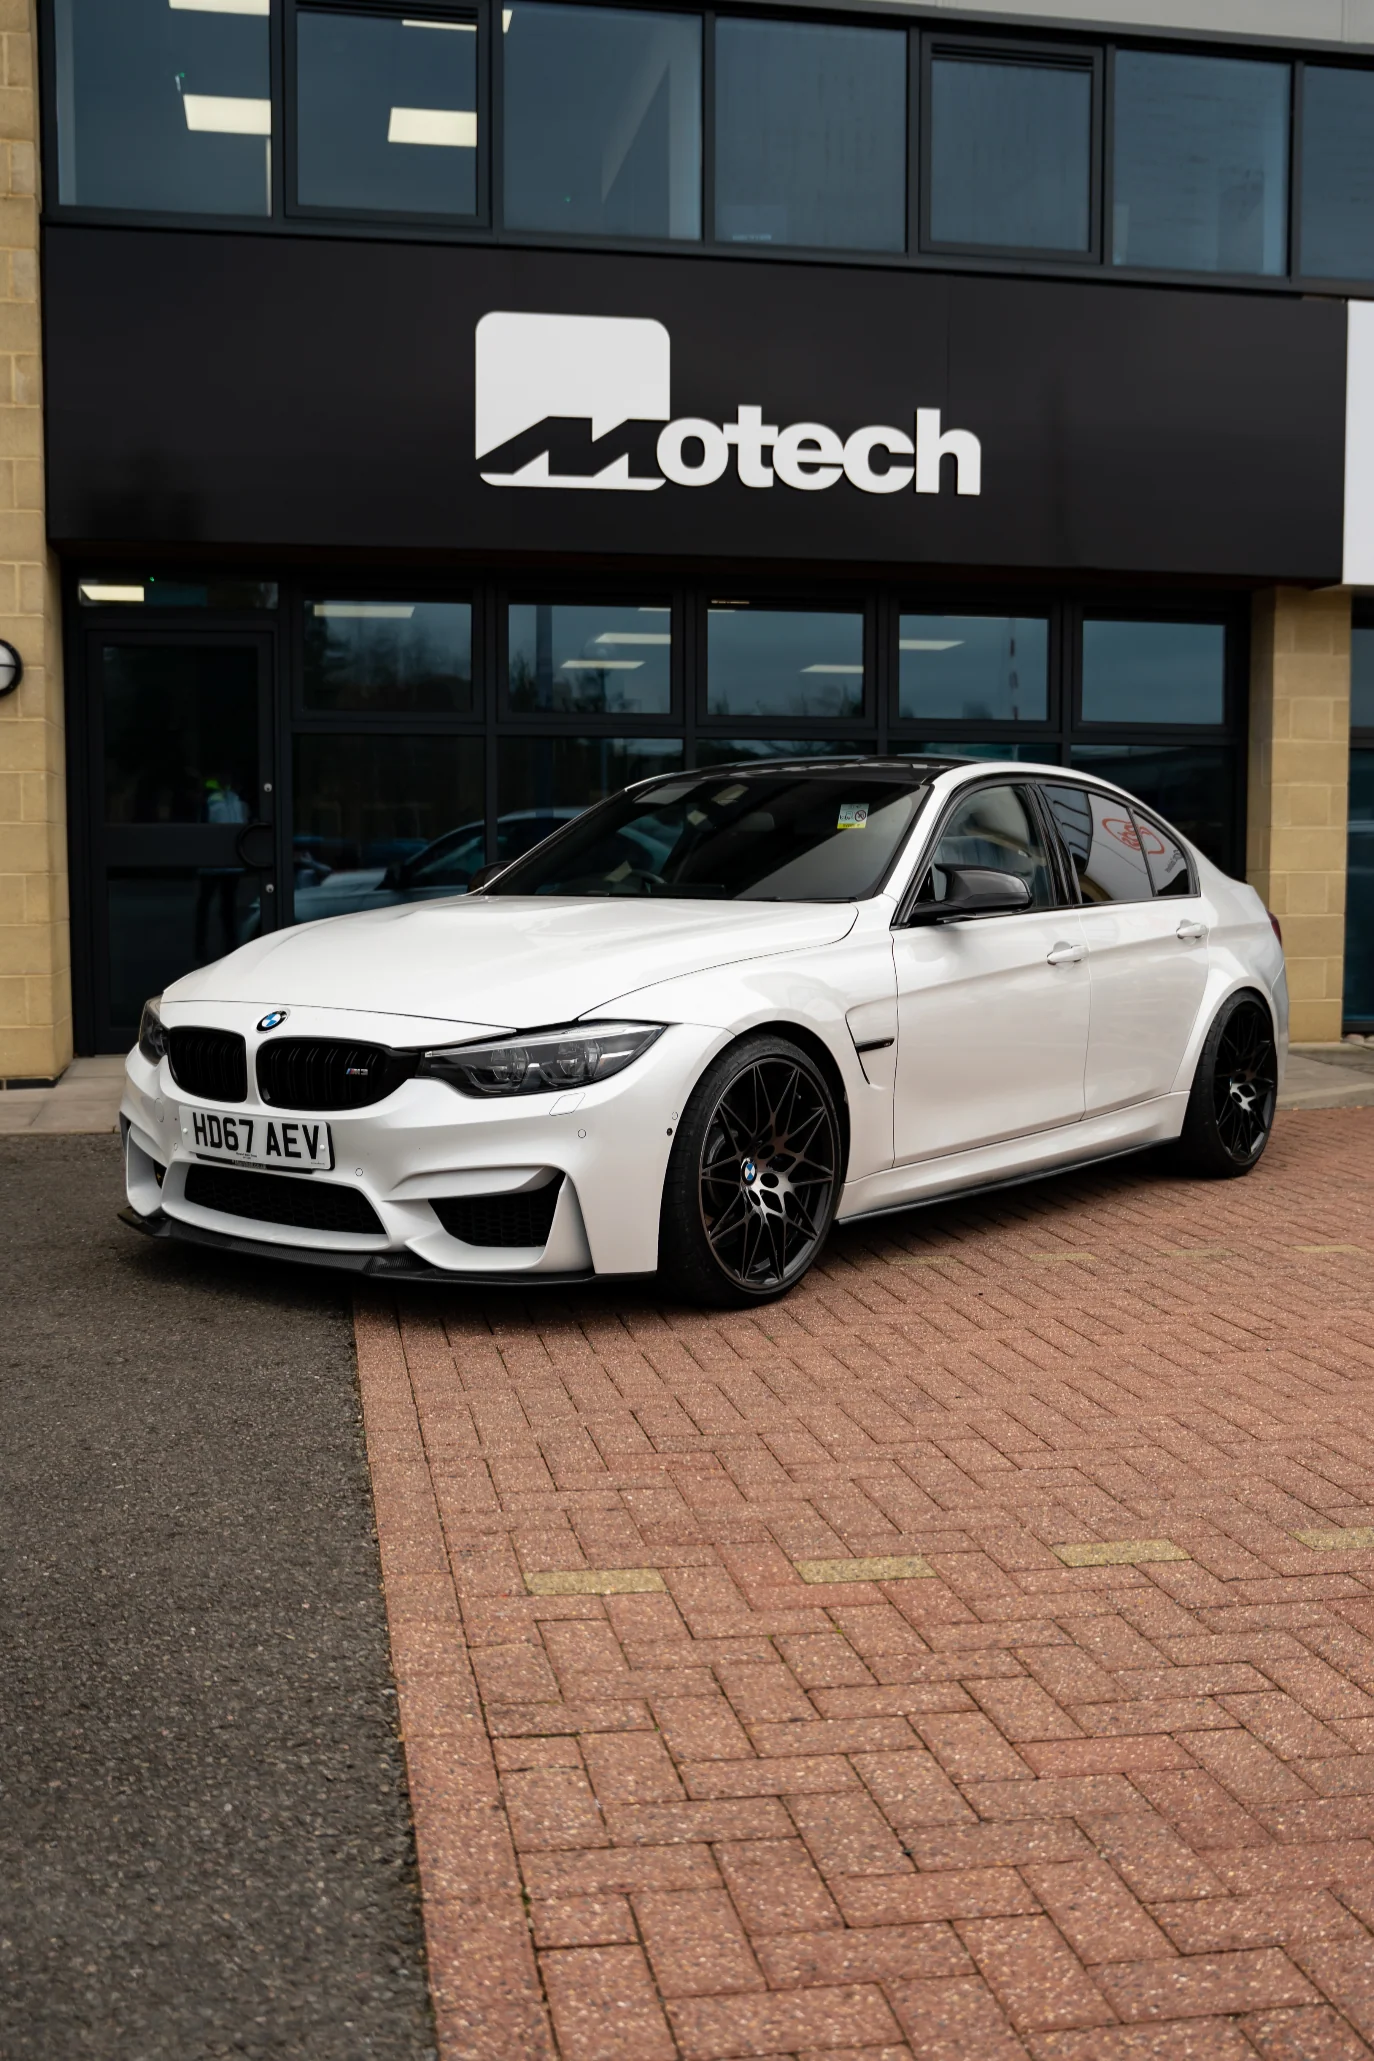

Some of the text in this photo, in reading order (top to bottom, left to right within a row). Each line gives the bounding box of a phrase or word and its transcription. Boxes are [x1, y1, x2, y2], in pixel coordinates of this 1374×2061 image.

[475, 311, 982, 496] Motech
[191, 1111, 319, 1160] HD67 AEV
